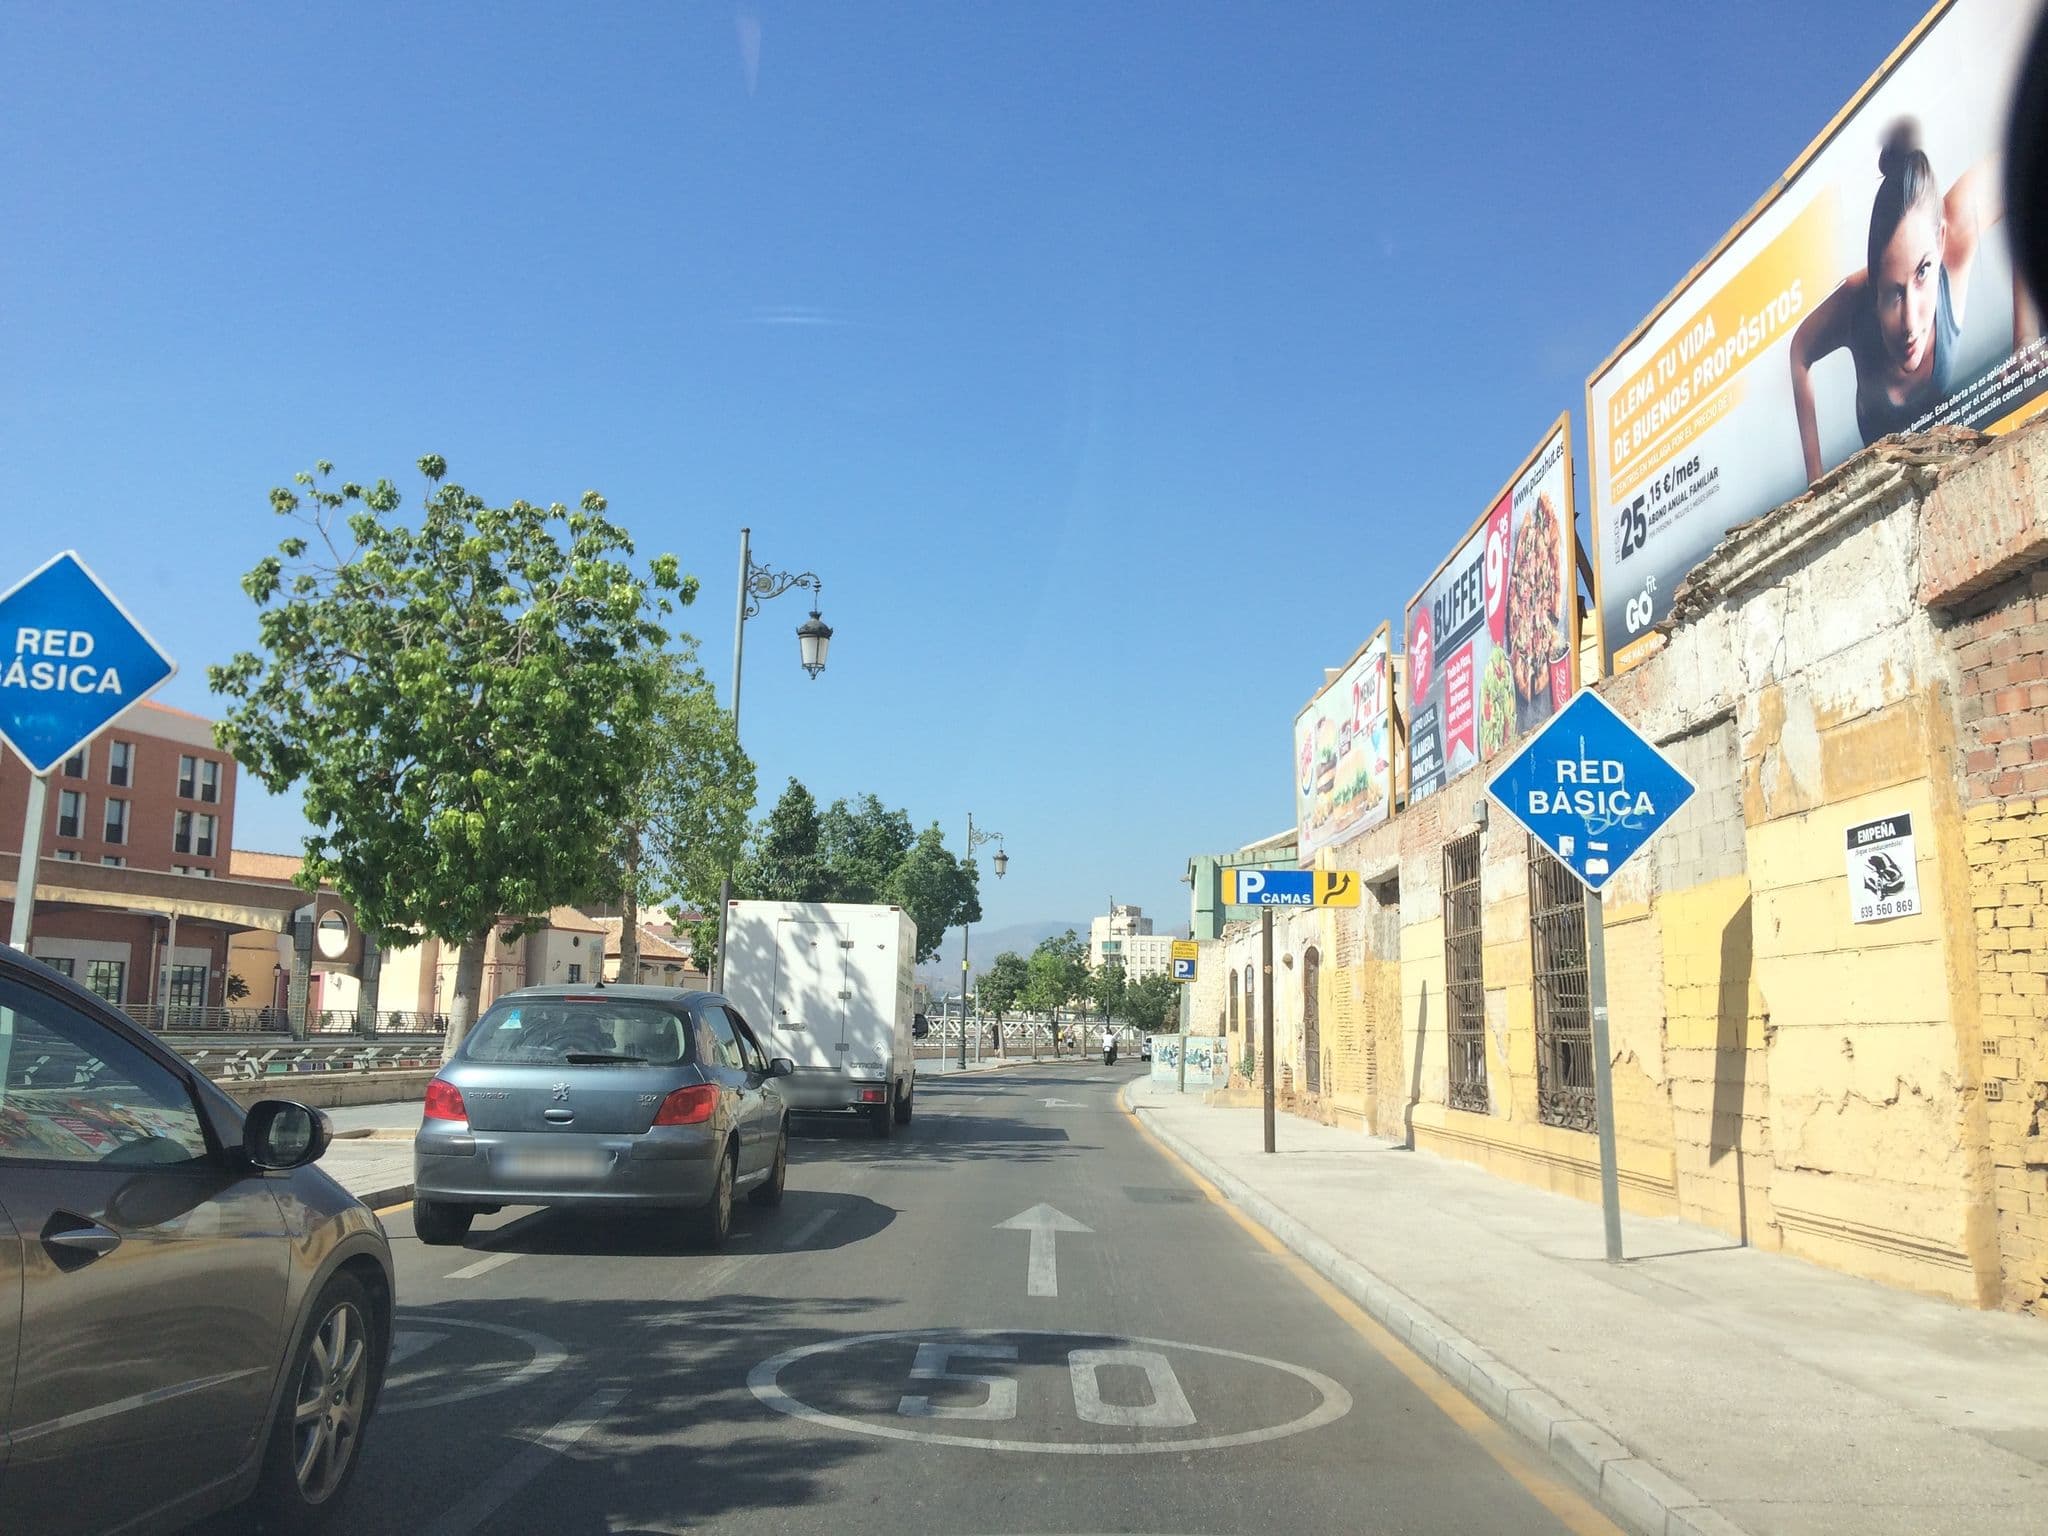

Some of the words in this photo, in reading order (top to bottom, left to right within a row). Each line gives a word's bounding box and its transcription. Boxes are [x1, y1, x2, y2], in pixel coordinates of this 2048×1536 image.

[1614, 371, 1655, 429] LLENA
[1657, 348, 1676, 385] TU
[1678, 313, 1715, 365] VIDA
[1614, 429, 1631, 465] DE
[1632, 378, 1690, 448] BUENOS
[1693, 278, 1803, 396] PROPÓSITOS
[1935, 402, 1949, 416] Esta
[1949, 389, 1968, 407] oferta
[1969, 382, 1977, 394] no
[1978, 376, 1986, 387] es
[1987, 355, 2018, 383] aplicable
[1961, 402, 1972, 417] por
[1973, 396, 1980, 407] el
[1980, 382, 2001, 401] centro
[1963, 395, 2001, 427] información
[1648, 505, 1667, 527] ABONO
[1668, 490, 1688, 512] ANUAL
[1689, 467, 1719, 496] FAMILIAR
[1487, 531, 1503, 618] 9
[1646, 575, 1657, 594] fit
[1434, 551, 1484, 646] BUFFET
[1626, 590, 1653, 634] GO
[16, 627, 94, 658] RED
[0, 655, 122, 695] ÁSICA
[1556, 760, 1624, 784] RED
[1529, 786, 1655, 815] BÁSICA
[1857, 821, 1896, 844] EMPEÑA
[1239, 871, 1265, 904] P
[1261, 893, 1311, 904] CAMAS
[1861, 903, 1873, 918] 639
[1876, 902, 1893, 916] 560
[1896, 900, 1913, 914] 869
[1174, 960, 1188, 977] P
[469, 1092, 511, 1101] PEUGEOT
[639, 1094, 658, 1103] 307
[897, 1342, 1197, 1428] 50
